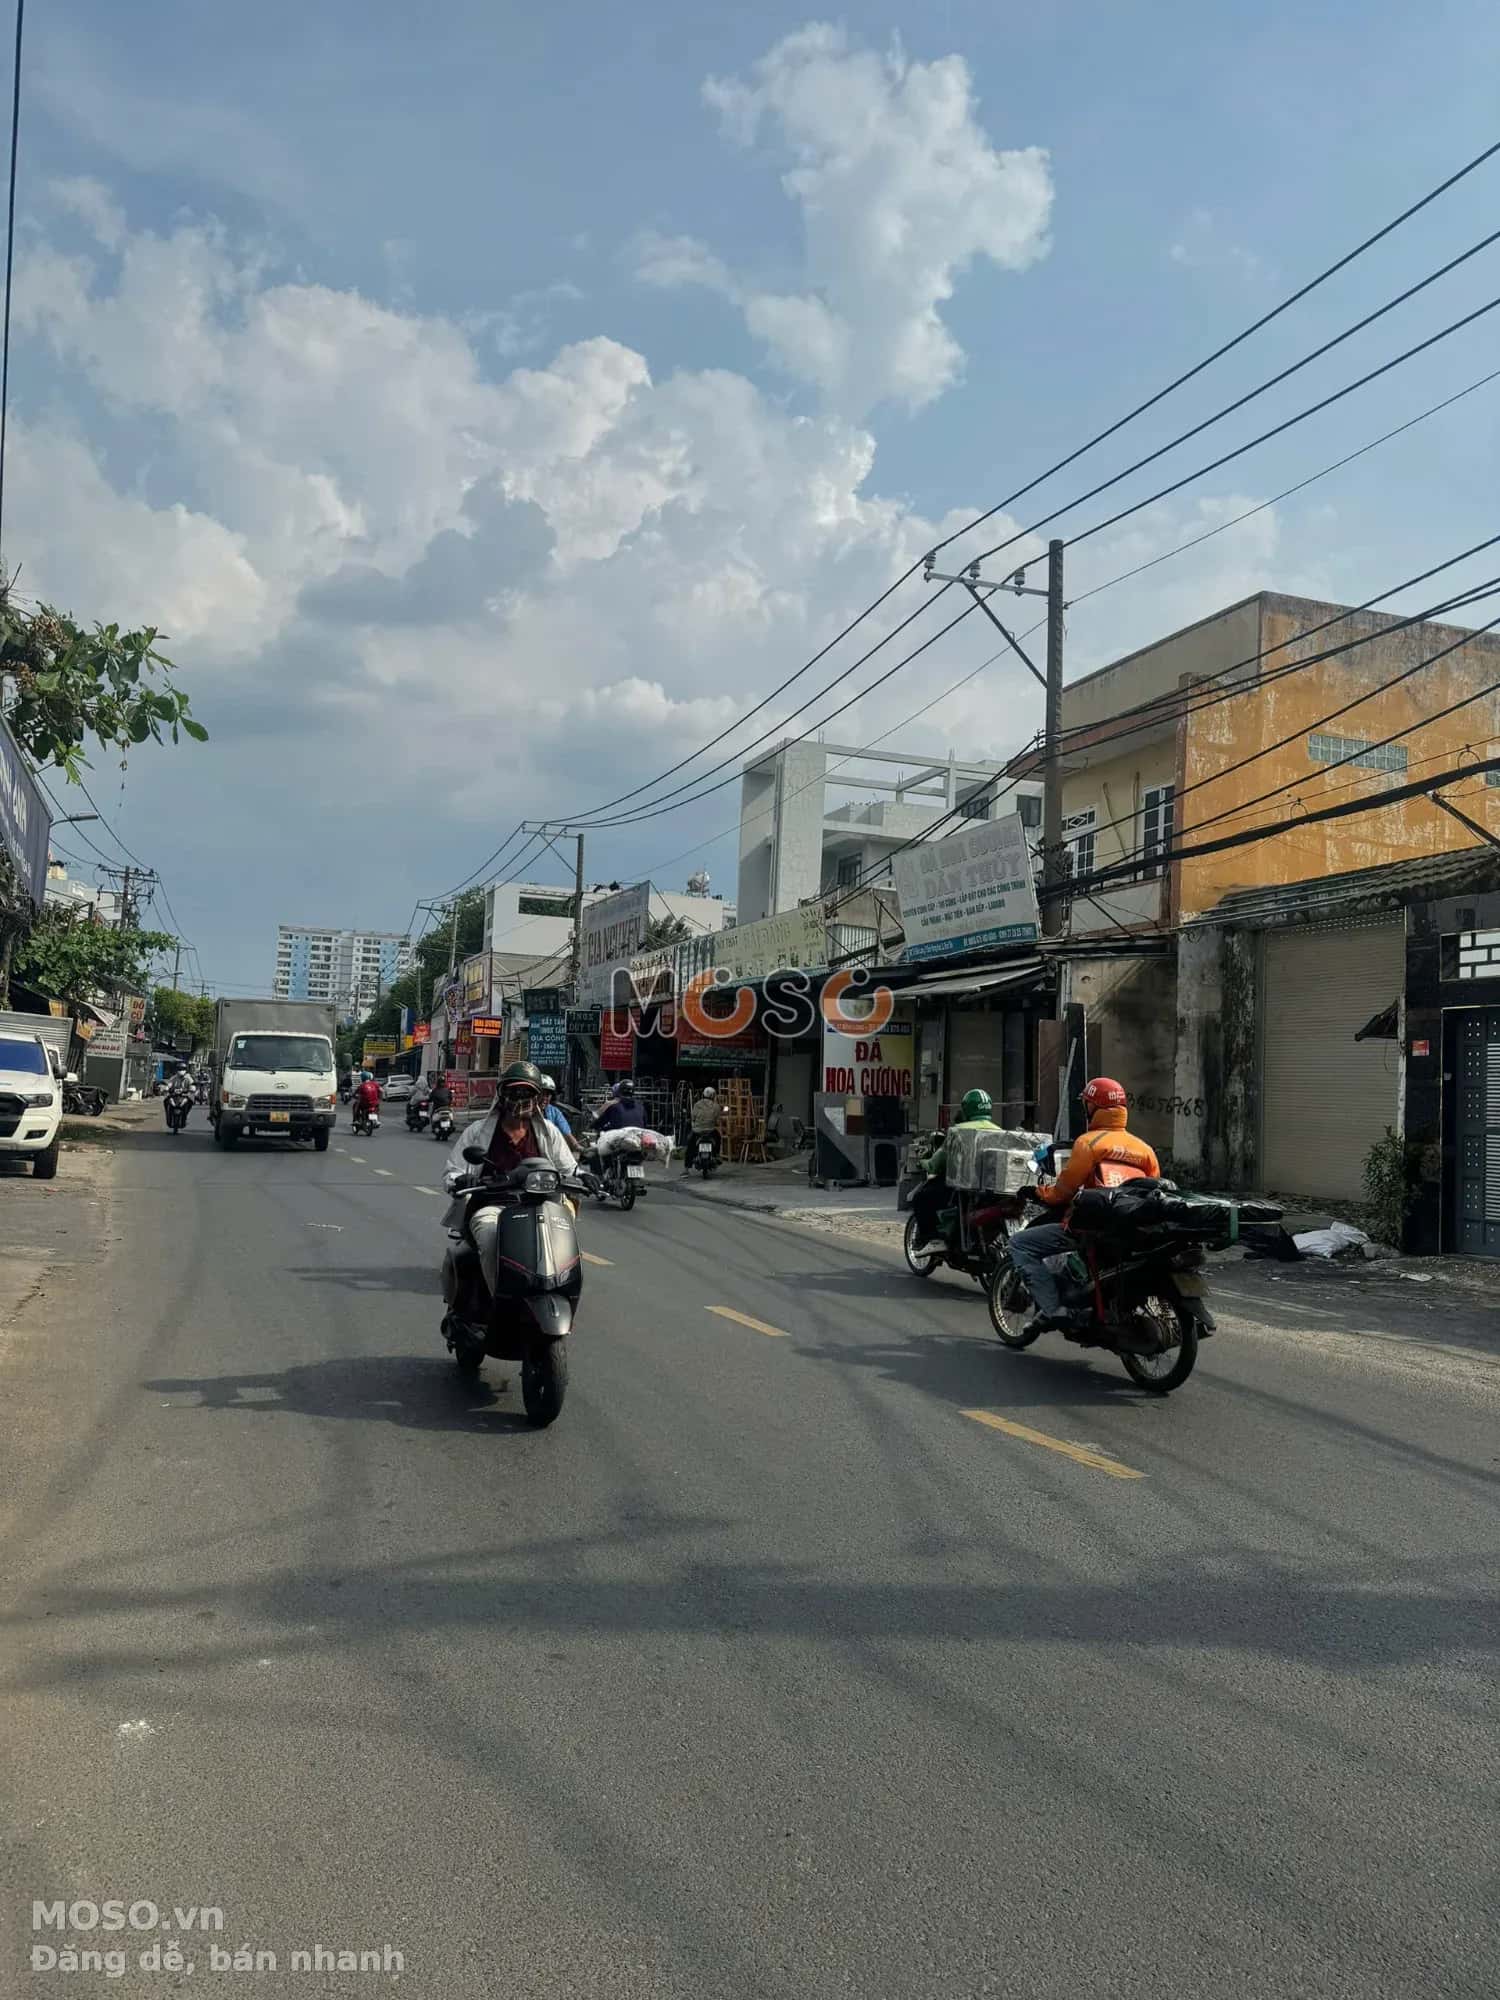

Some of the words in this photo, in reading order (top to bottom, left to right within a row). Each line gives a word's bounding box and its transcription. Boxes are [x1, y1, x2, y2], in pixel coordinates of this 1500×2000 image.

[855, 1037, 883, 1063] ĐÁ
[825, 1067, 856, 1095] HOA
[860, 1066, 913, 1097] CƯƠNG
